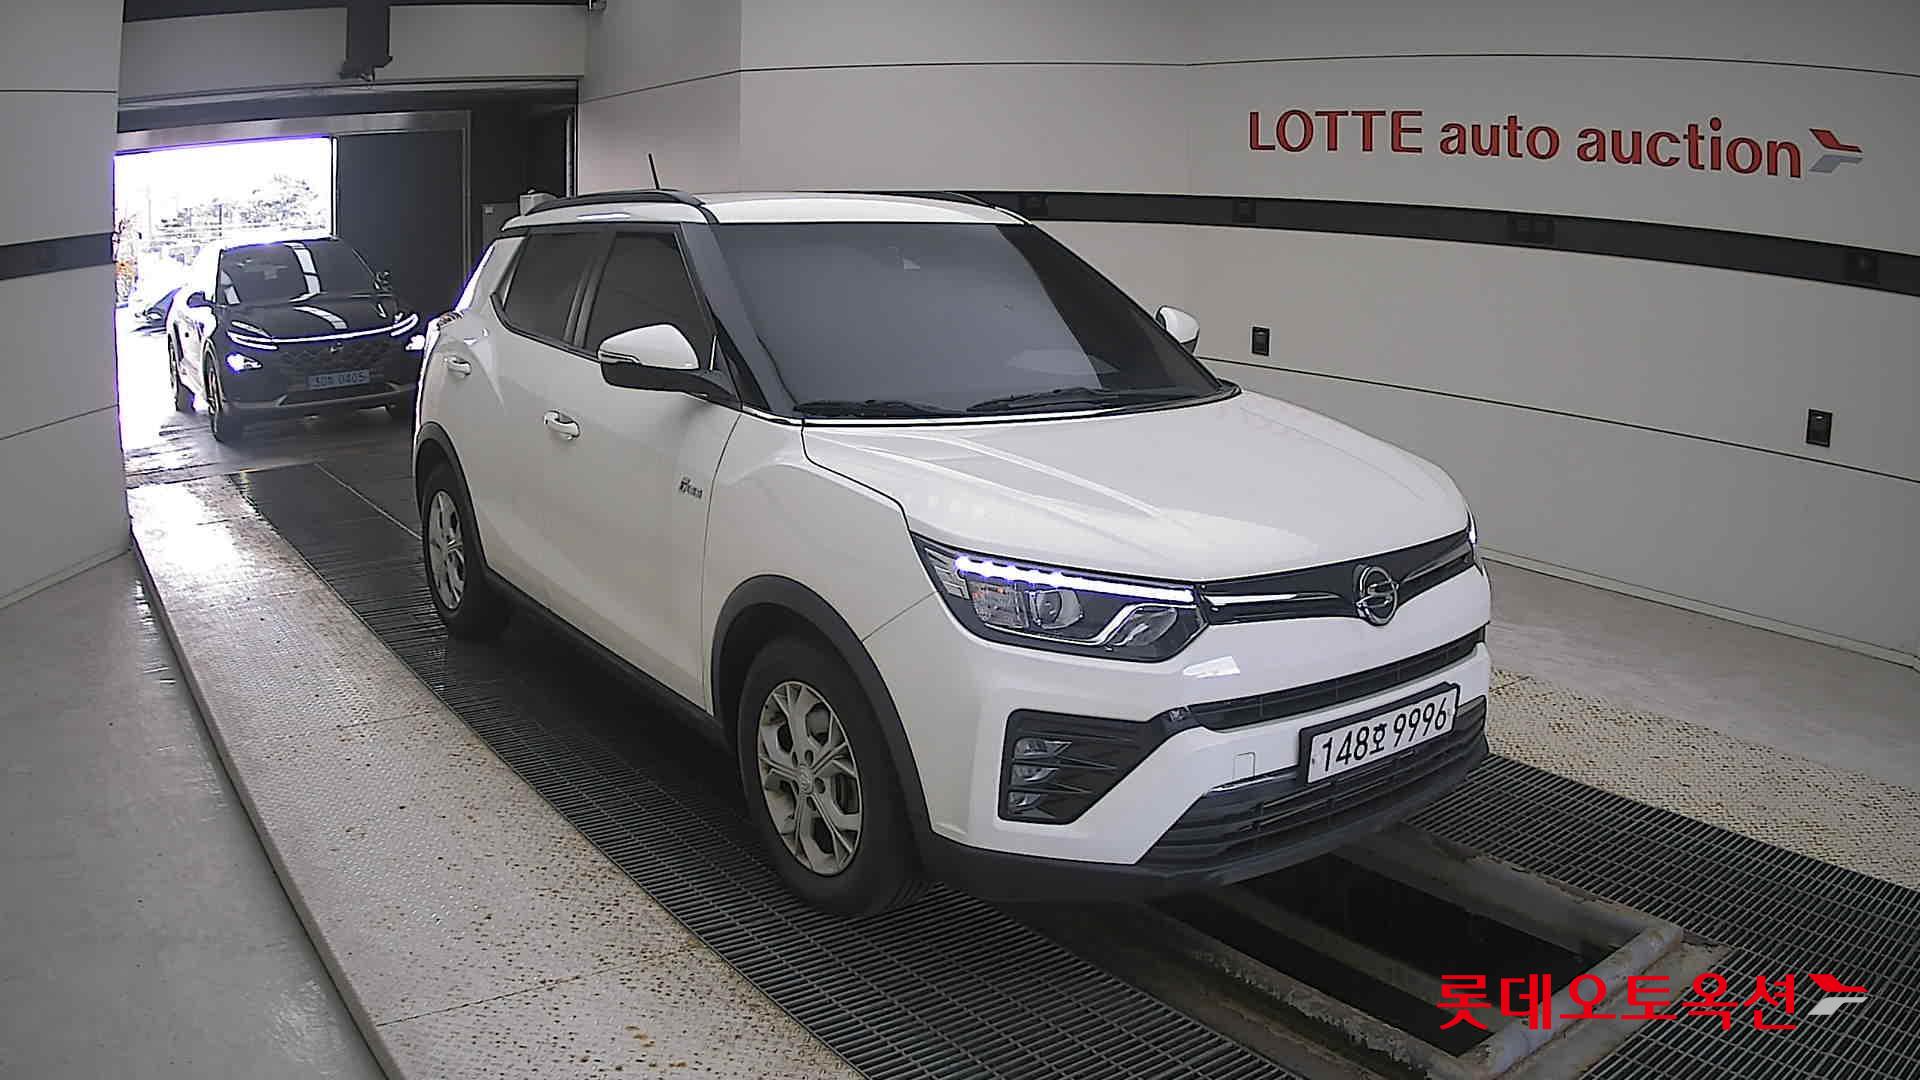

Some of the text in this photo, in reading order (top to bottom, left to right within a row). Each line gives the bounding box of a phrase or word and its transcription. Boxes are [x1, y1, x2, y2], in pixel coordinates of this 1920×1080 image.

[1249, 110, 1802, 178] LOTTE auto auction
[1322, 697, 1447, 771] 148호 9996
